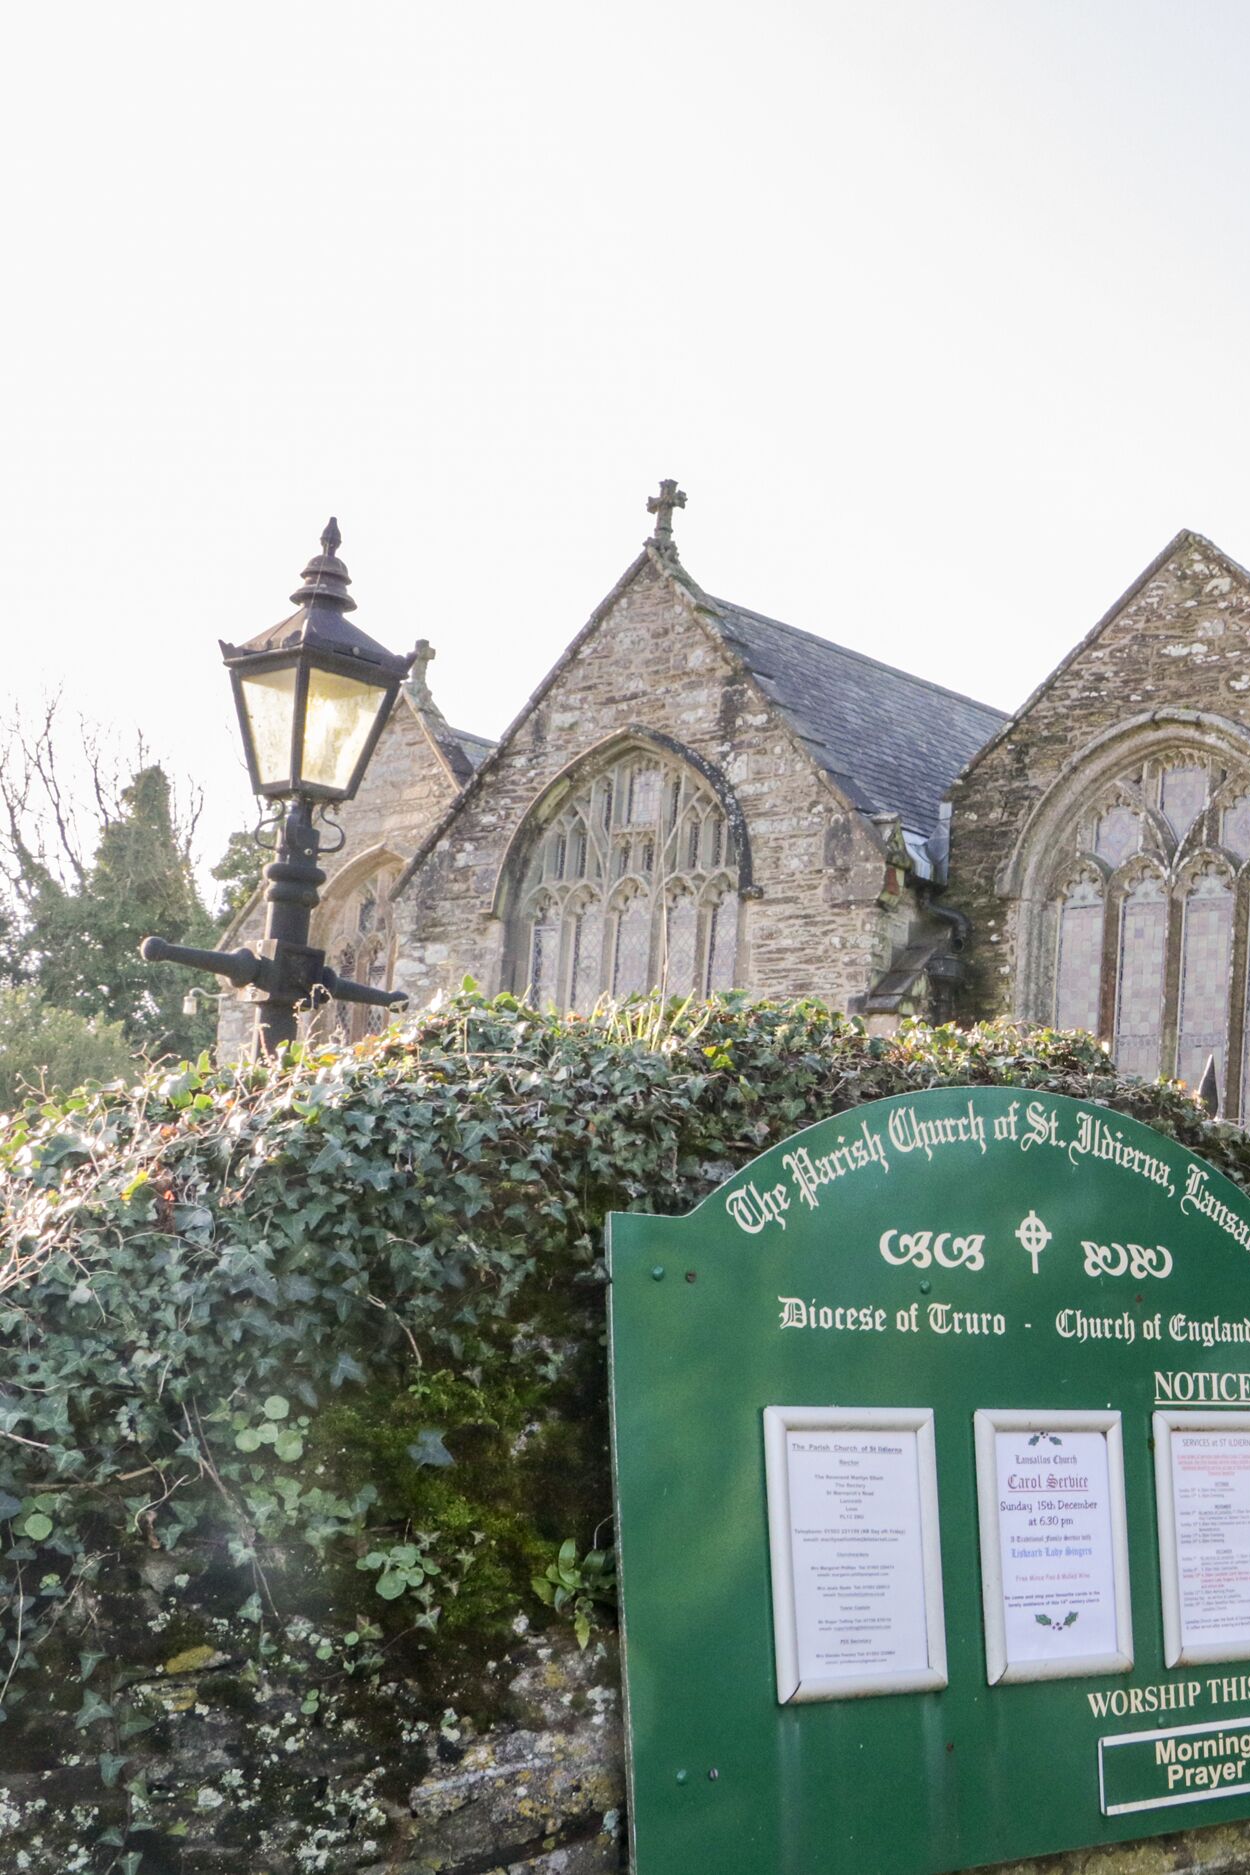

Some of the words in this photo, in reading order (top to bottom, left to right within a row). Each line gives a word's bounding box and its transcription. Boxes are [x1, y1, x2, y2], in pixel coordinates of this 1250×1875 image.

[726, 1181, 791, 1234] The
[782, 1121, 889, 1211] Parish
[888, 1100, 987, 1161] Church
[994, 1101, 1020, 1141] of
[1020, 1101, 1067, 1151] St.
[1069, 1111, 1177, 1199] Ildierna,
[778, 1296, 888, 1332] Diocese
[895, 1302, 920, 1333] of
[927, 1302, 1007, 1336] Truro
[1056, 1309, 1139, 1344] Church
[1143, 1314, 1164, 1340] of
[1182, 1438, 1210, 1447] SERVICES
[1219, 1439, 1226, 1447] ST
[1015, 1454, 1051, 1465] Lansallos
[1053, 1454, 1077, 1465] Church
[1007, 1473, 1042, 1490] Carol
[1047, 1473, 1089, 1489] Service
[1000, 1500, 1033, 1513] Sunday
[1037, 1500, 1055, 1511] 15th
[1057, 1499, 1098, 1510] December
[1028, 1517, 1037, 1526] at
[1060, 1517, 1074, 1528] pm
[1087, 1681, 1201, 1718] WORSHIP
[1167, 1759, 1247, 1790] Prayer
